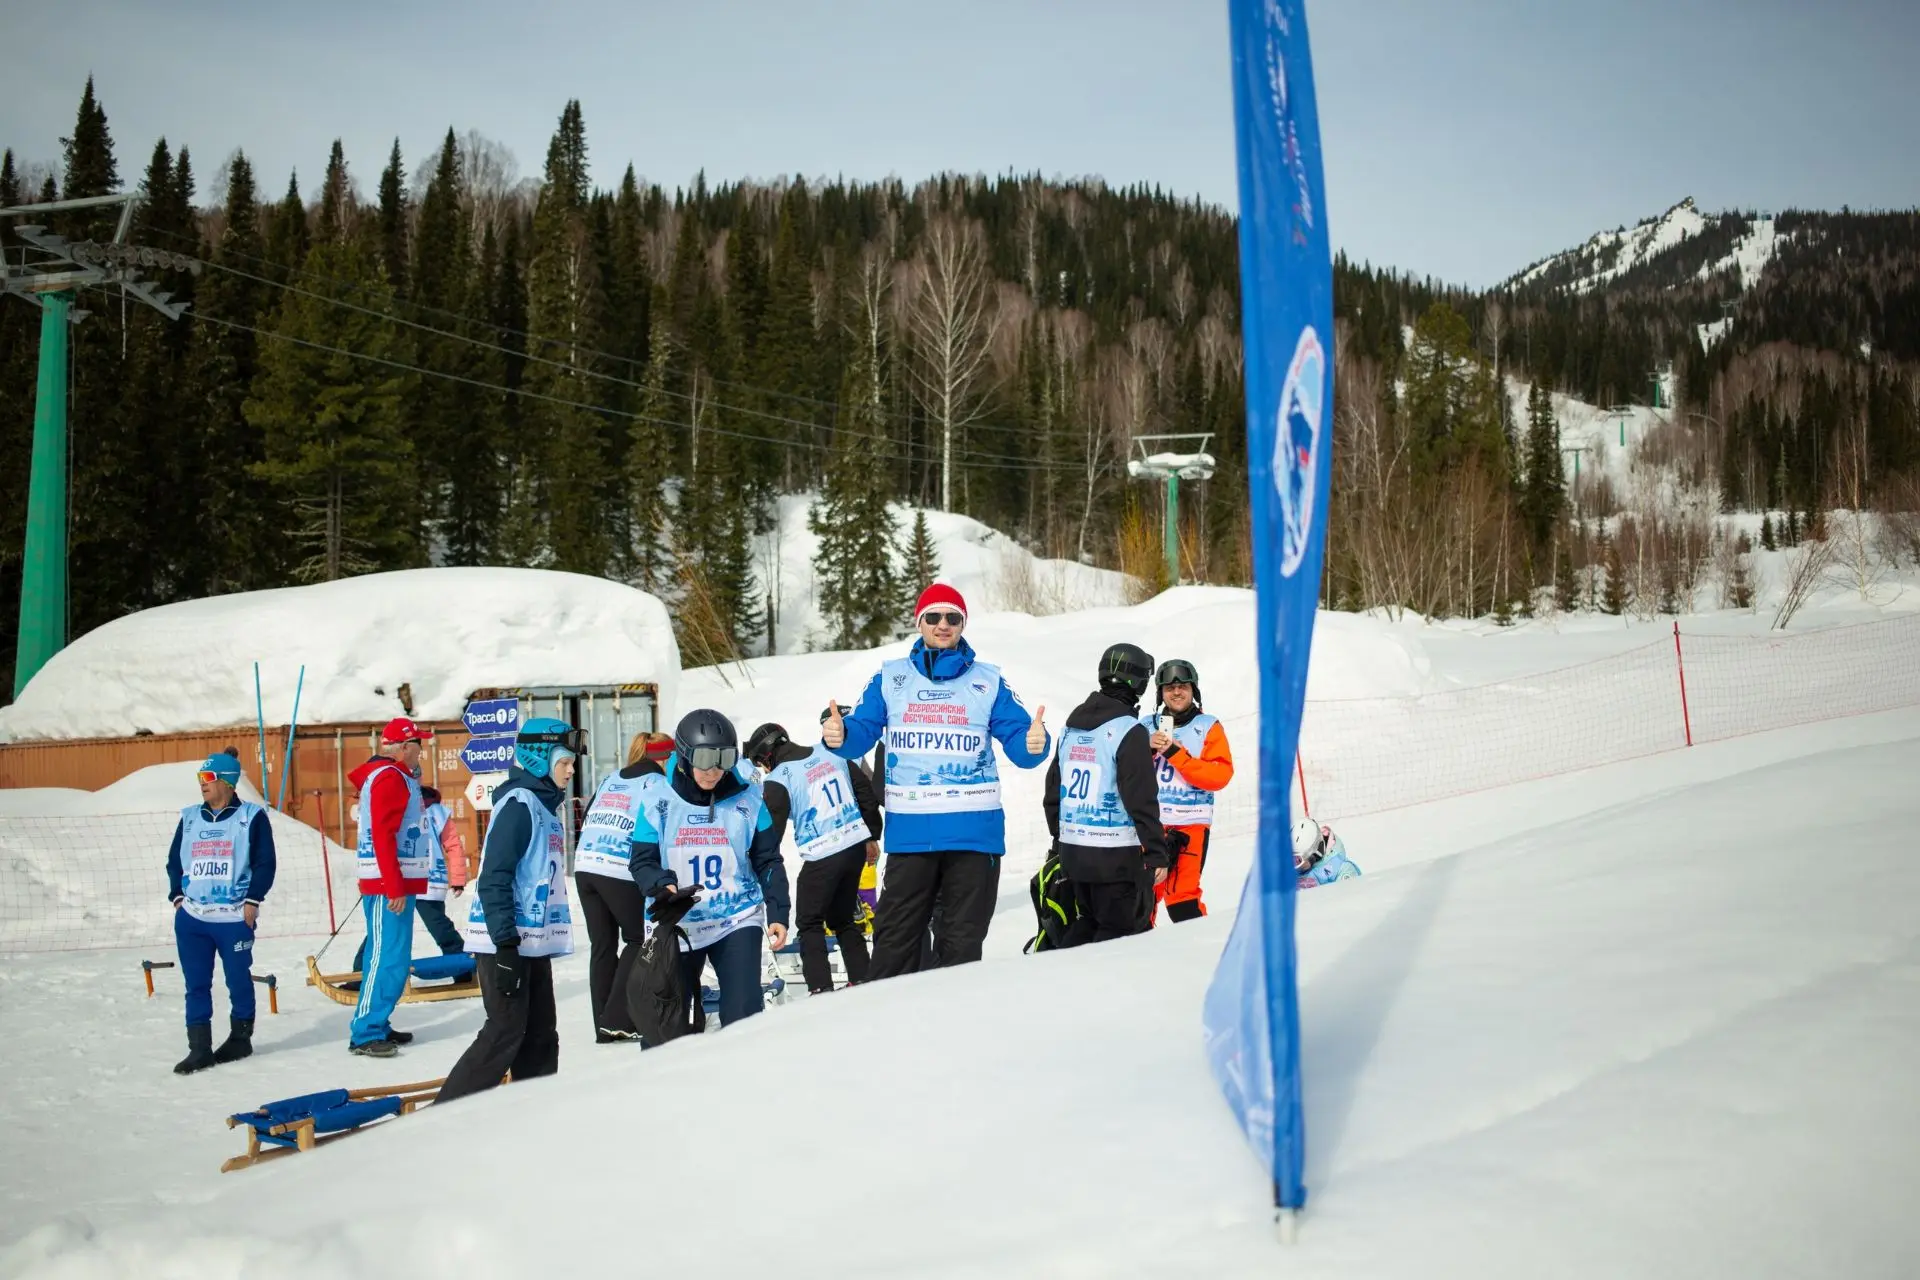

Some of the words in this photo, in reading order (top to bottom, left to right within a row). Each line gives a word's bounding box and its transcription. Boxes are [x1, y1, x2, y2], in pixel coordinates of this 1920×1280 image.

[908, 703, 966, 715] ВСЕРОССИЙСКИЙ
[466, 712, 496, 727] Трасса
[903, 712, 944, 725] ФЕСТИВАЛЬ
[890, 731, 981, 752] ИНСТРУКТОР
[465, 749, 497, 764] Трасса
[822, 778, 842, 807] 17
[1068, 768, 1091, 800] 20
[584, 812, 634, 831] РГАНИЗАТОР
[193, 861, 229, 876] СУДЬЯ
[688, 854, 722, 890] 19
